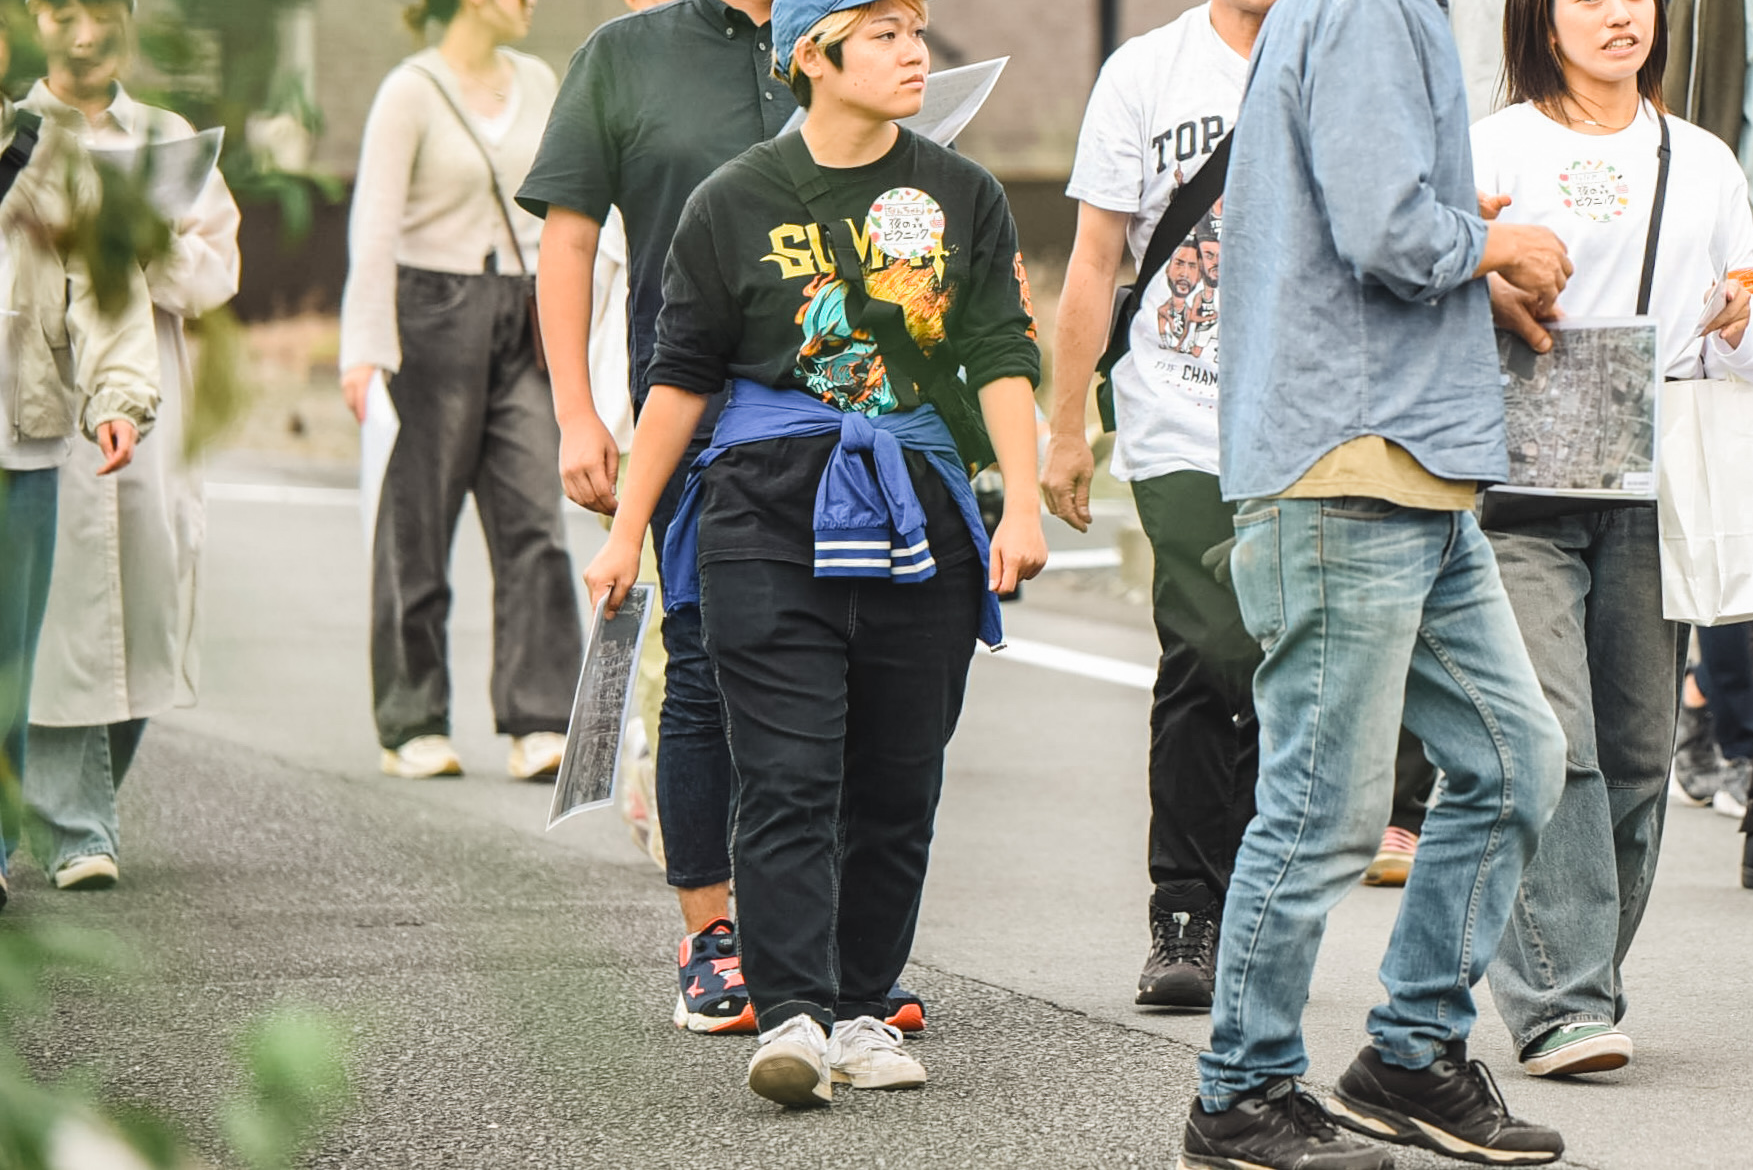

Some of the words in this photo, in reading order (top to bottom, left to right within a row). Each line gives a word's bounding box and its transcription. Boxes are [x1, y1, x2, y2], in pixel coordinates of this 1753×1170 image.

[883, 228, 929, 241] ピクニック
